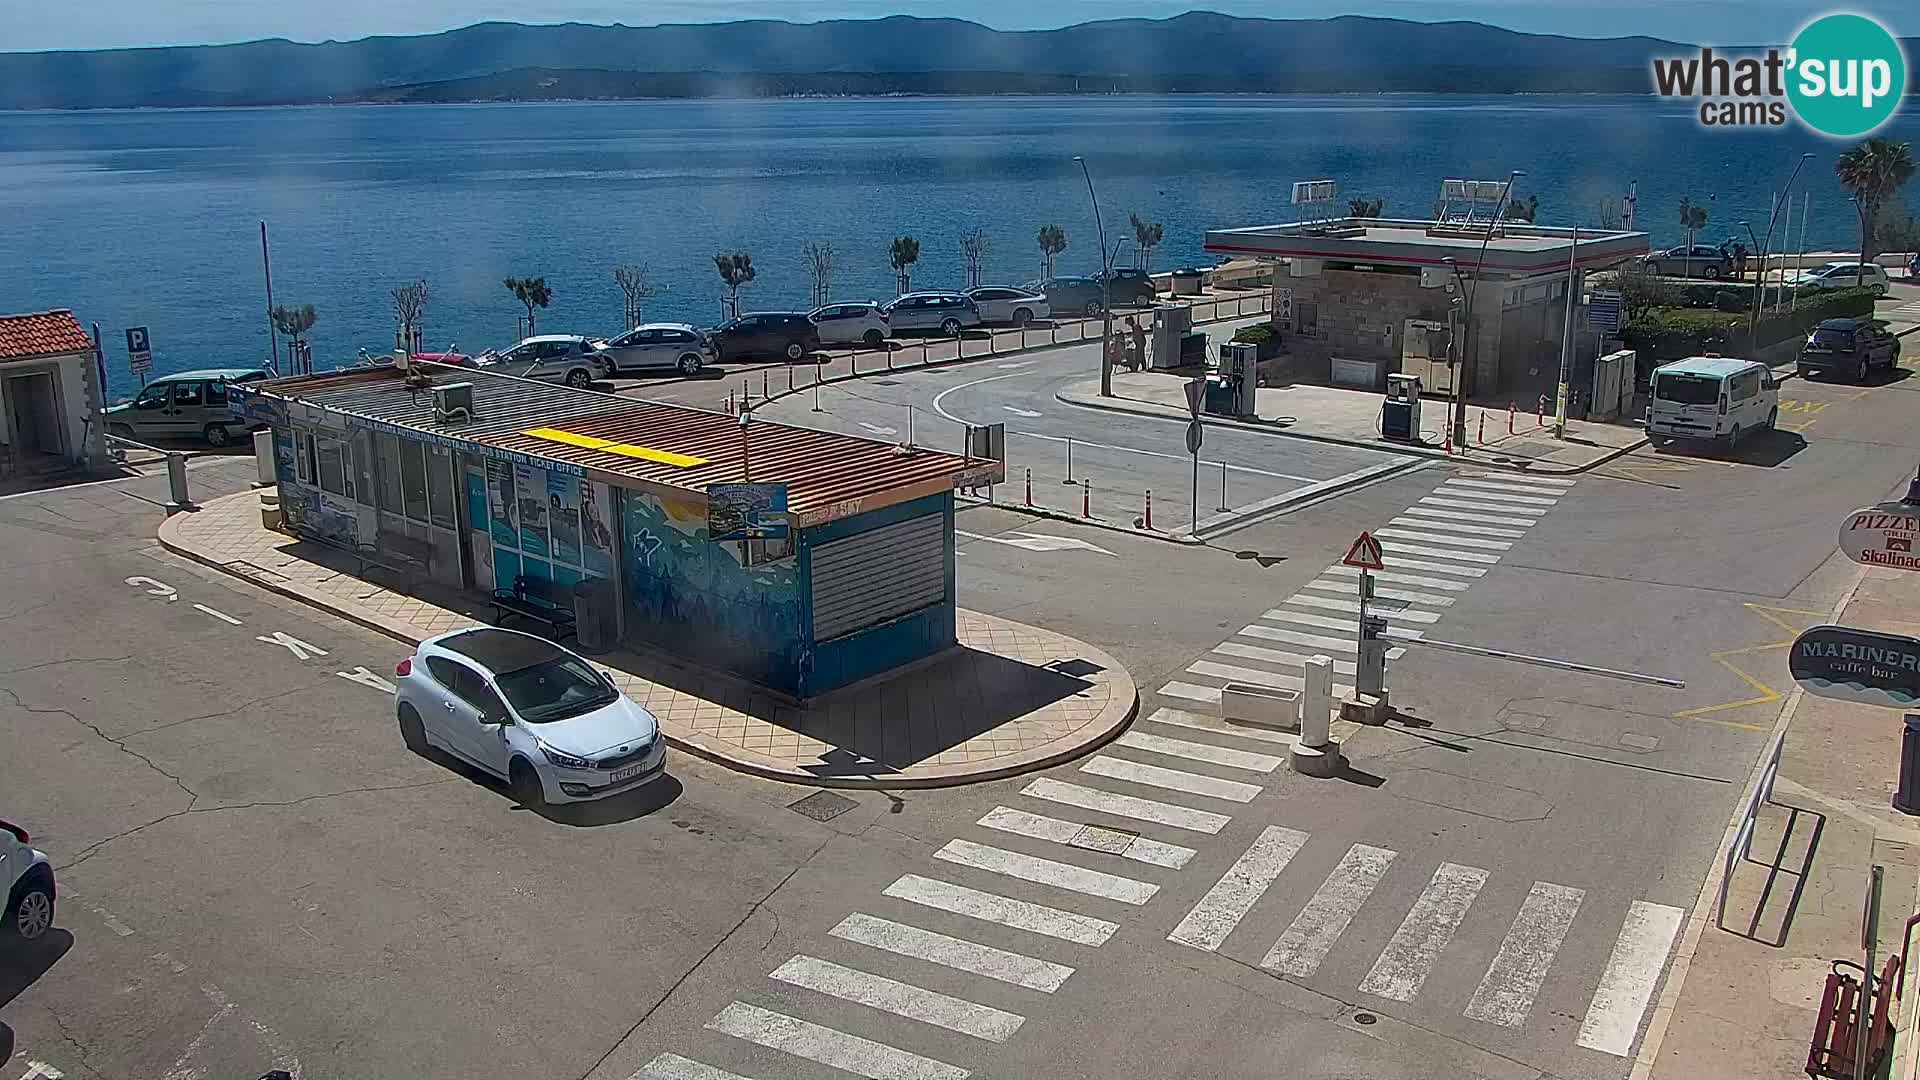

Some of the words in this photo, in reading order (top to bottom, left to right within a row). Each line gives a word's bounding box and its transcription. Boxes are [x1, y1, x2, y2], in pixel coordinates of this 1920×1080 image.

[132, 330, 144, 349] P
[496, 449, 527, 464] STATION
[529, 457, 555, 470] TICKET
[556, 463, 583, 476] OFFICE
[1850, 514, 1920, 531] PIZZE
[1829, 662, 1867, 674] caffe
[1871, 665, 1899, 680] bar
